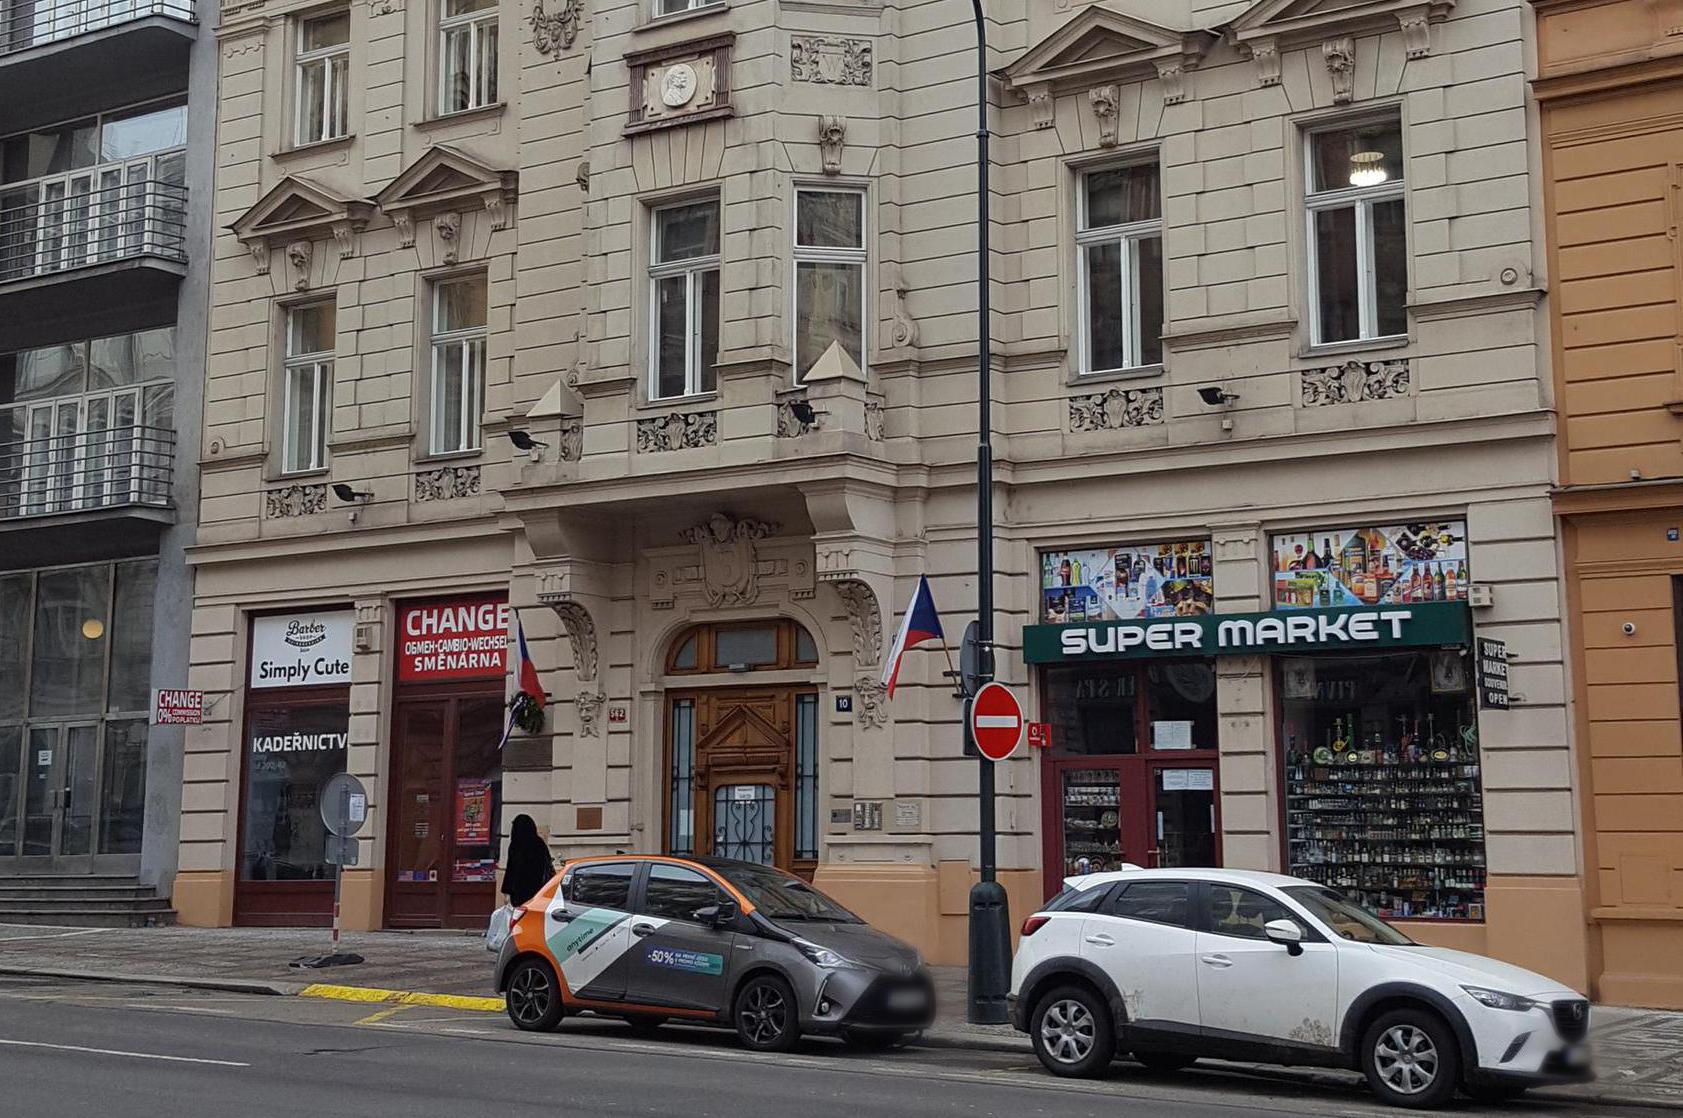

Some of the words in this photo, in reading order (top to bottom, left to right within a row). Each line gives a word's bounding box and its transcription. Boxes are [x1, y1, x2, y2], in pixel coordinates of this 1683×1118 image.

[286, 618, 326, 636] Barber
[406, 603, 509, 636] CHANGE
[1061, 621, 1203, 655] SUPER
[1218, 610, 1412, 648] MARKET
[259, 660, 311, 682] Simply
[314, 657, 350, 676] Cute
[414, 651, 501, 672] SMĚNÁRNA
[158, 690, 202, 708] CHANGE
[839, 699, 848, 708] 10
[1488, 691, 1508, 705] OPEN
[157, 708, 172, 723] 0%
[566, 927, 595, 952] anytime
[647, 950, 674, 965] -50%
